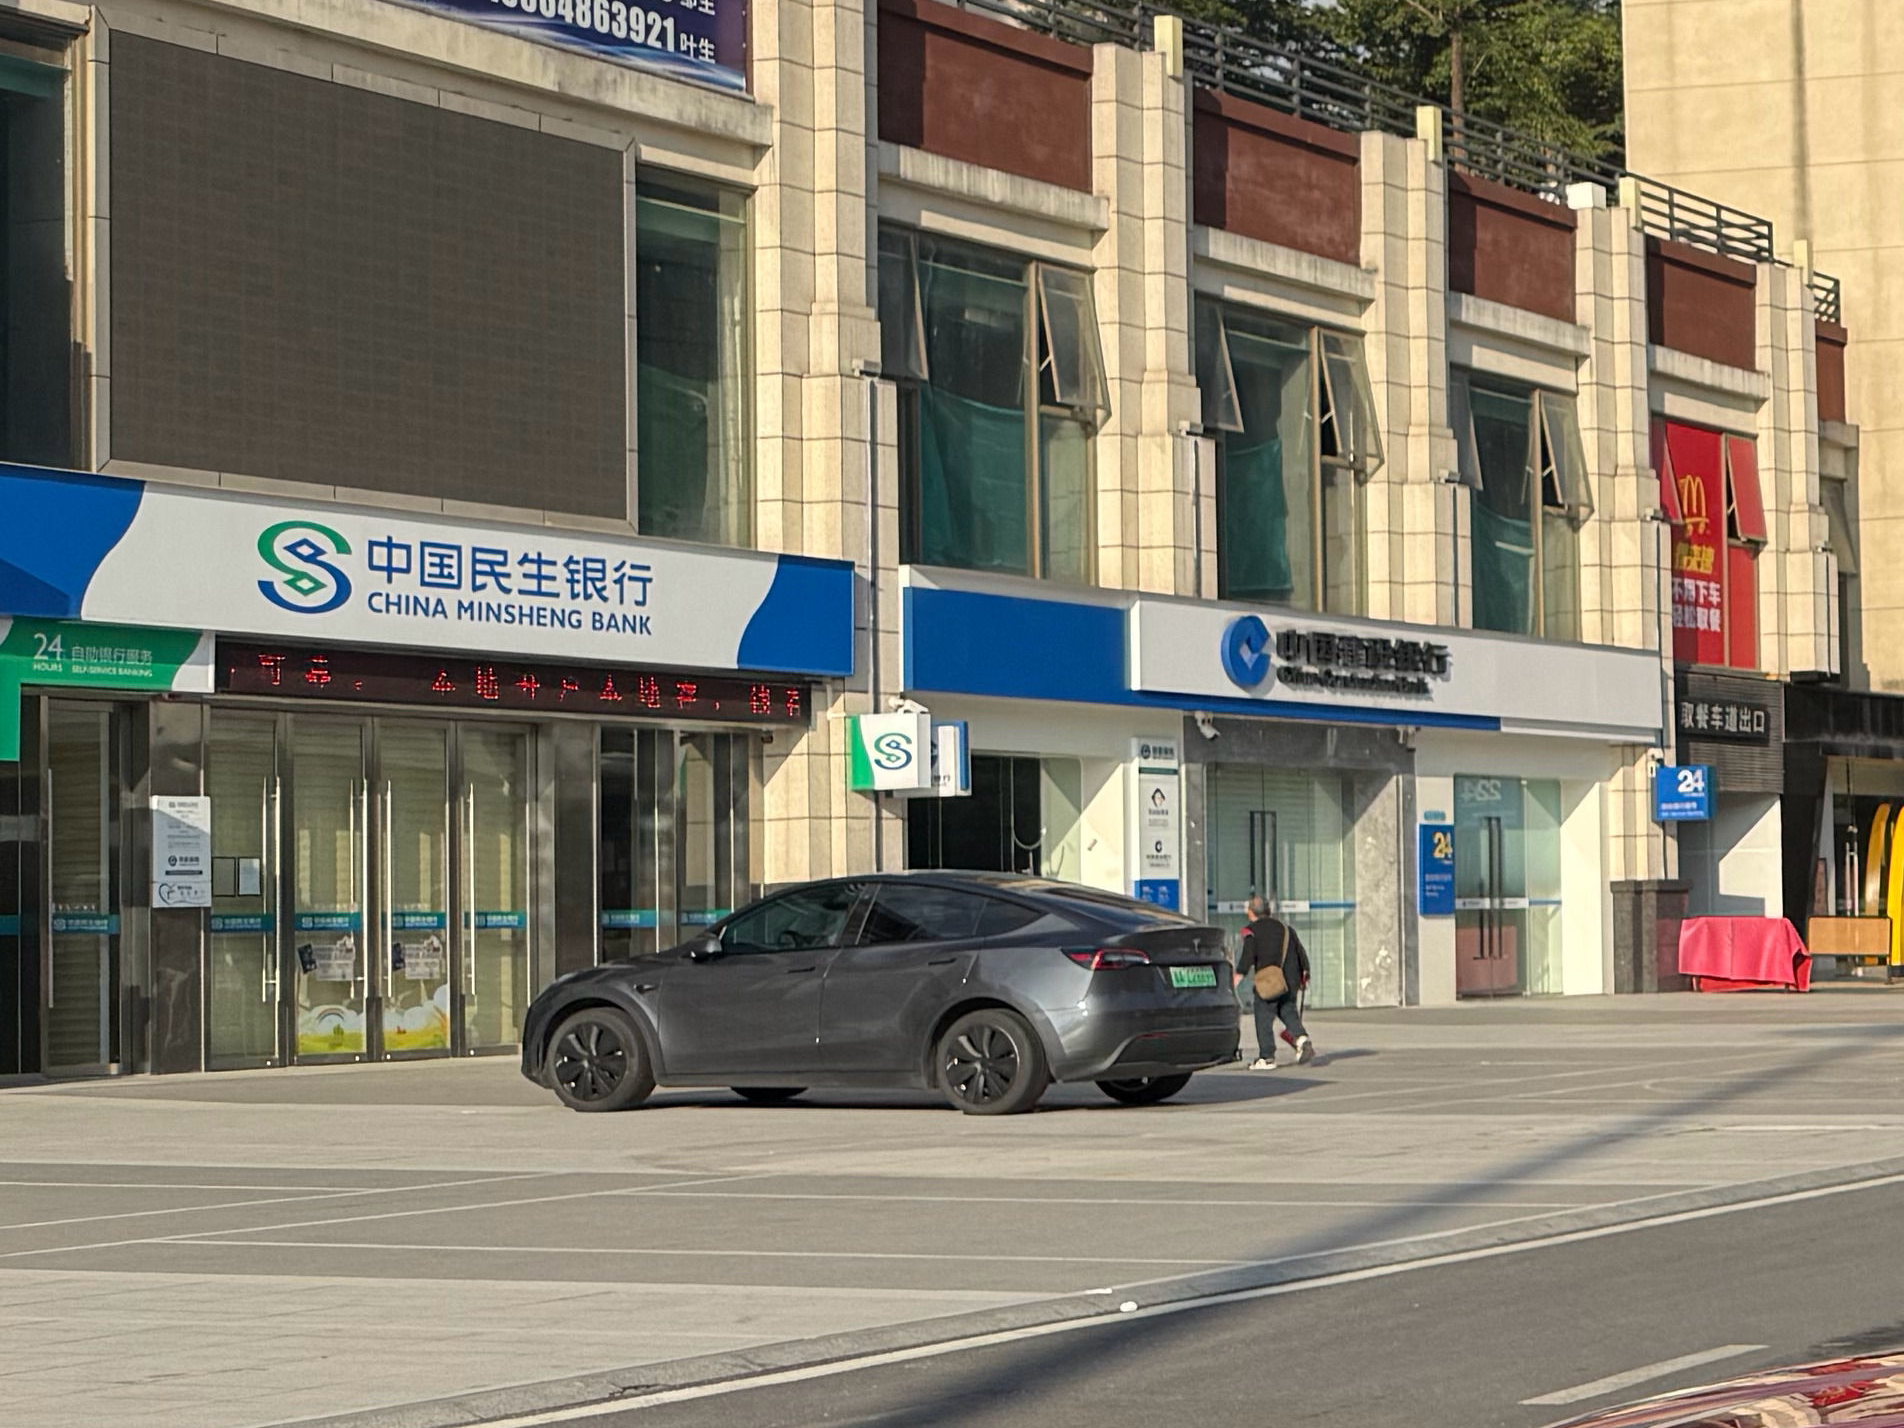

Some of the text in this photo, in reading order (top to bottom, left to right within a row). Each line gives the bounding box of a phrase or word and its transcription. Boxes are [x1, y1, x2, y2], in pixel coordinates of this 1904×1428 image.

[680, 33, 716, 64] 叶生
[368, 535, 653, 606] 中国民生银行
[368, 592, 652, 636] CHINA MINSHENG BANK
[33, 633, 64, 661] 24
[1678, 769, 1704, 792] 24
[1433, 832, 1452, 859] 24
